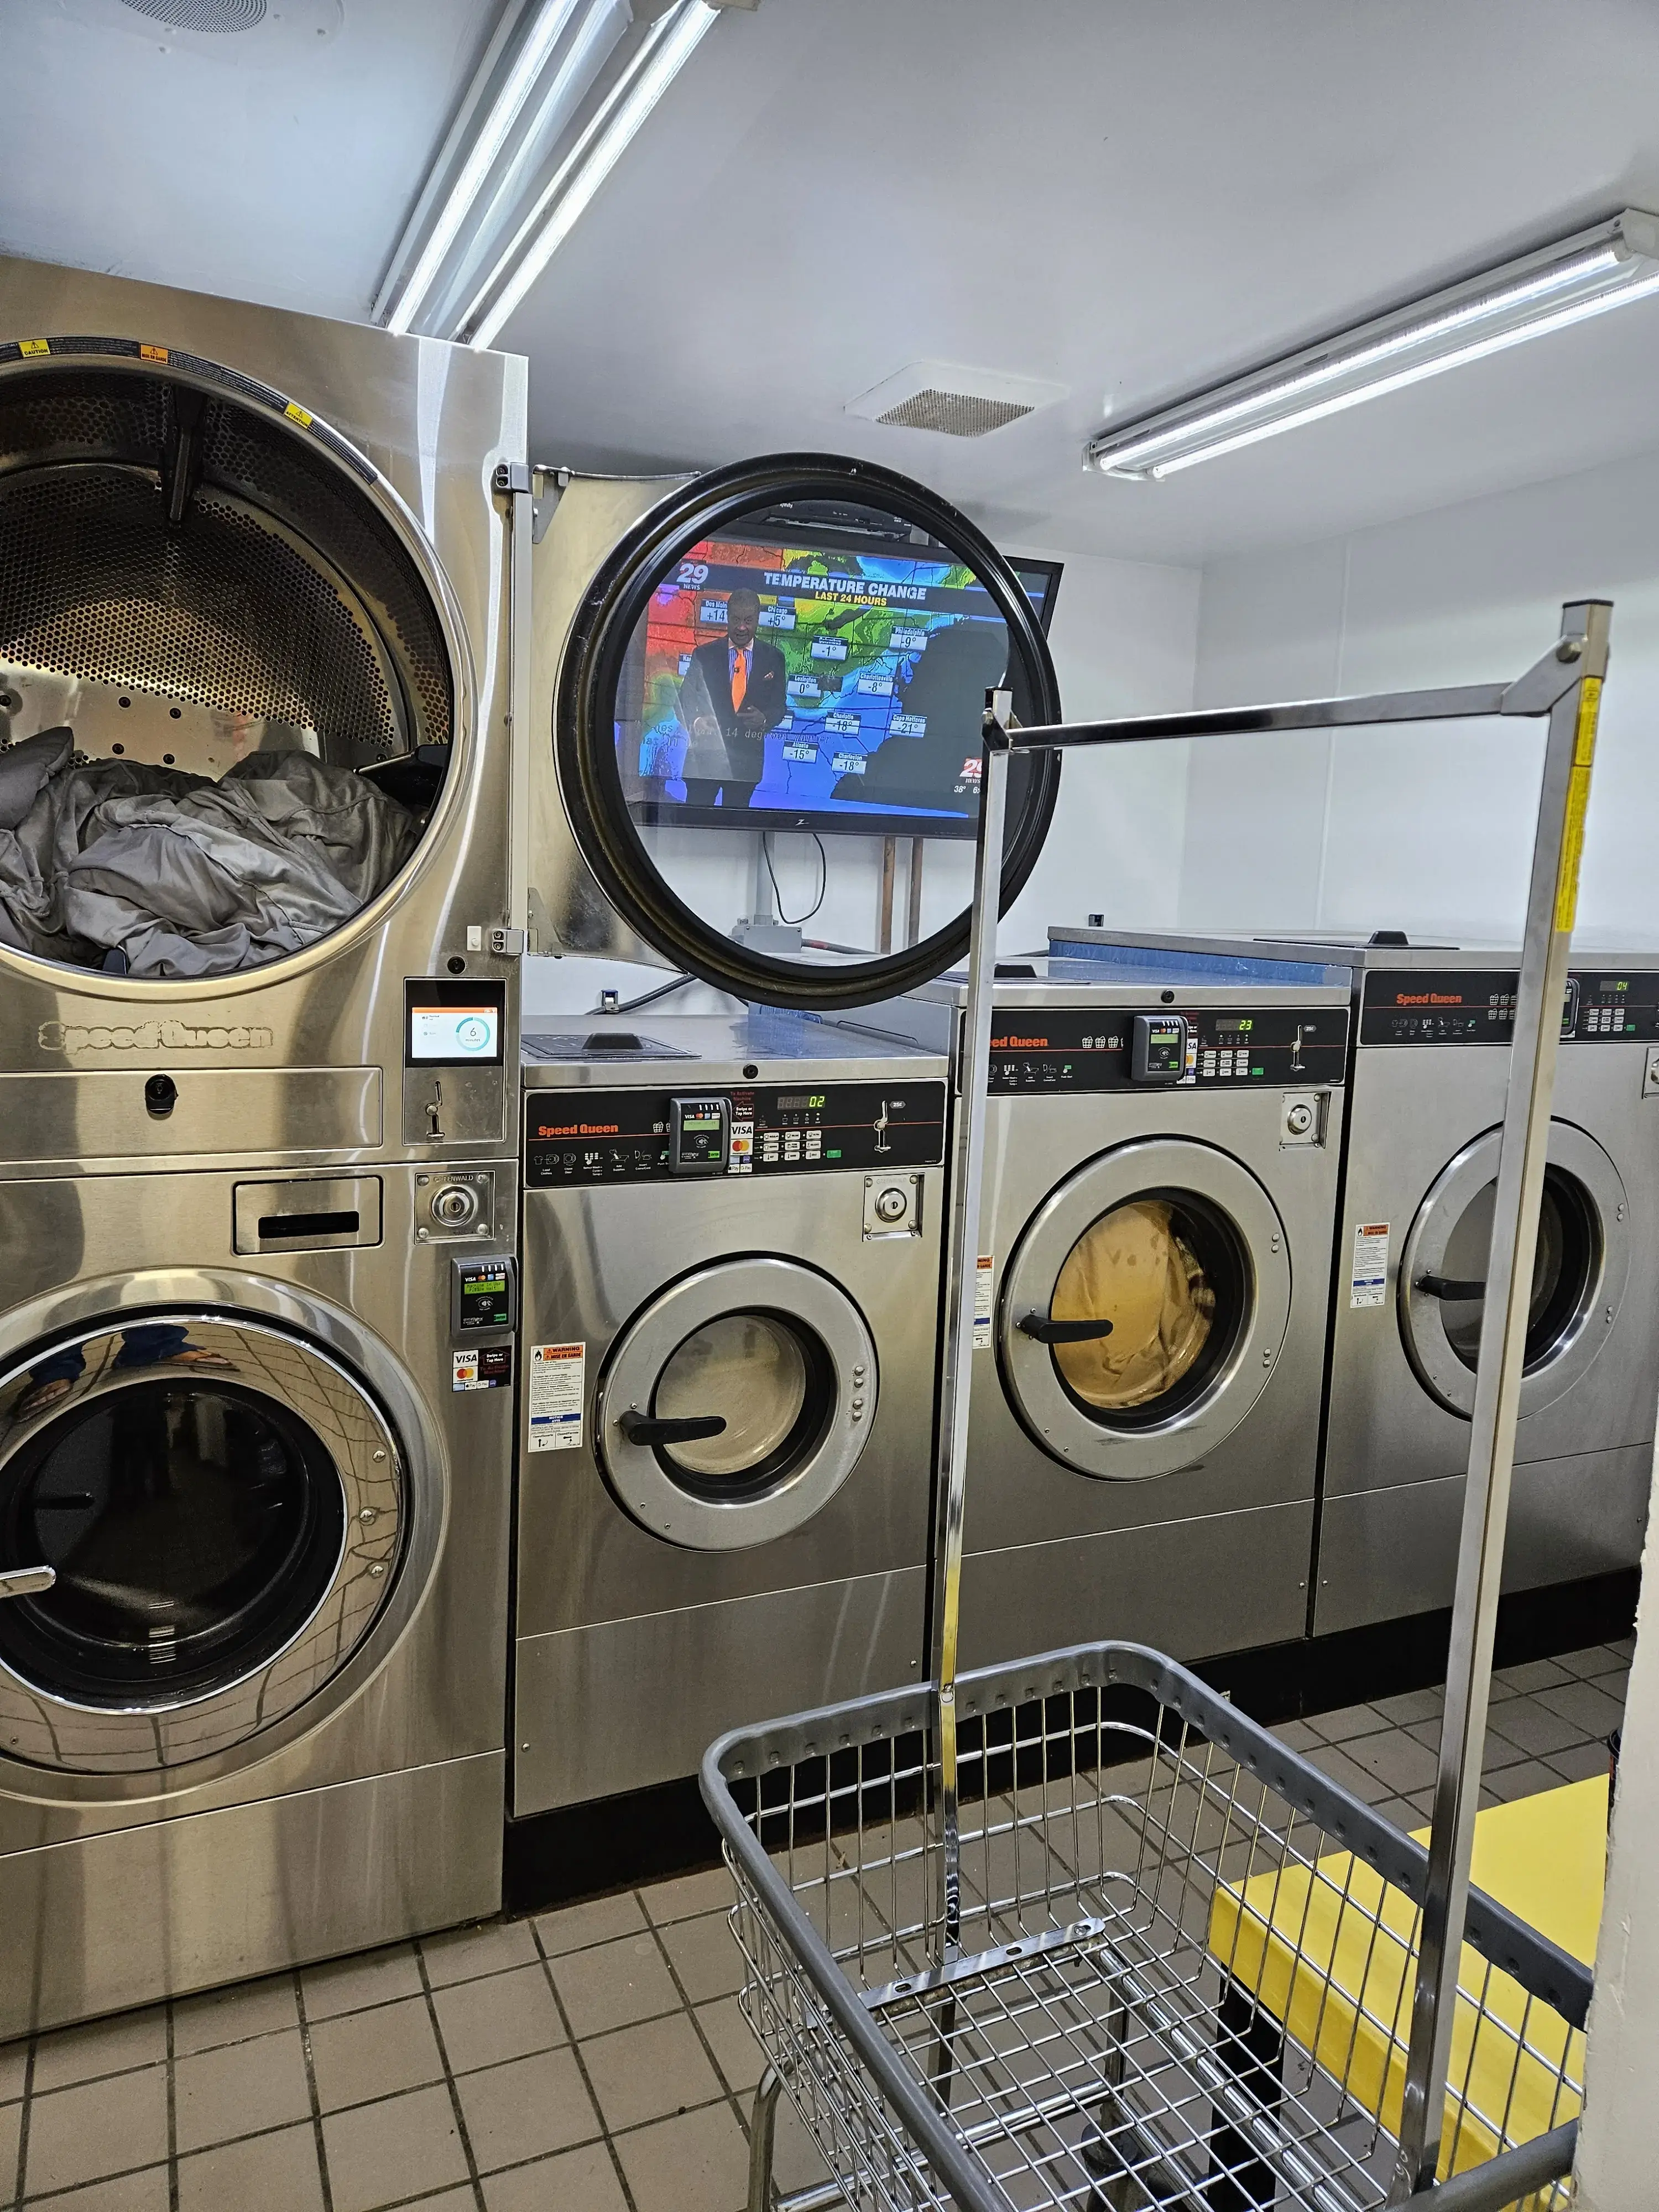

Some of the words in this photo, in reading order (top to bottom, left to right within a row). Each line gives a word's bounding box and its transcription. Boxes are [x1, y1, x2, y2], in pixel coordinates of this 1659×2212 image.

[286, 411, 308, 427] ATTENTION
[676, 563, 708, 584] 29
[764, 572, 865, 594] TEMPERATURE
[868, 582, 927, 601] CHANGE
[815, 591, 839, 601] LAST
[840, 593, 852, 603] 24
[853, 594, 888, 606] HOURS
[768, 606, 787, 614] Chicago
[1617, 982, 1627, 990] 04
[1396, 993, 1429, 1005] Speed
[1431, 993, 1462, 1003] Queen
[1239, 1020, 1253, 1030] 23
[470, 1027, 476, 1036] 6
[1009, 1036, 1048, 1047] Queen
[809, 1095, 825, 1107] 02
[538, 1124, 578, 1137] Speed
[580, 1124, 618, 1134] Queen
[731, 1126, 753, 1135] VISA
[455, 1354, 477, 1363] VISA
